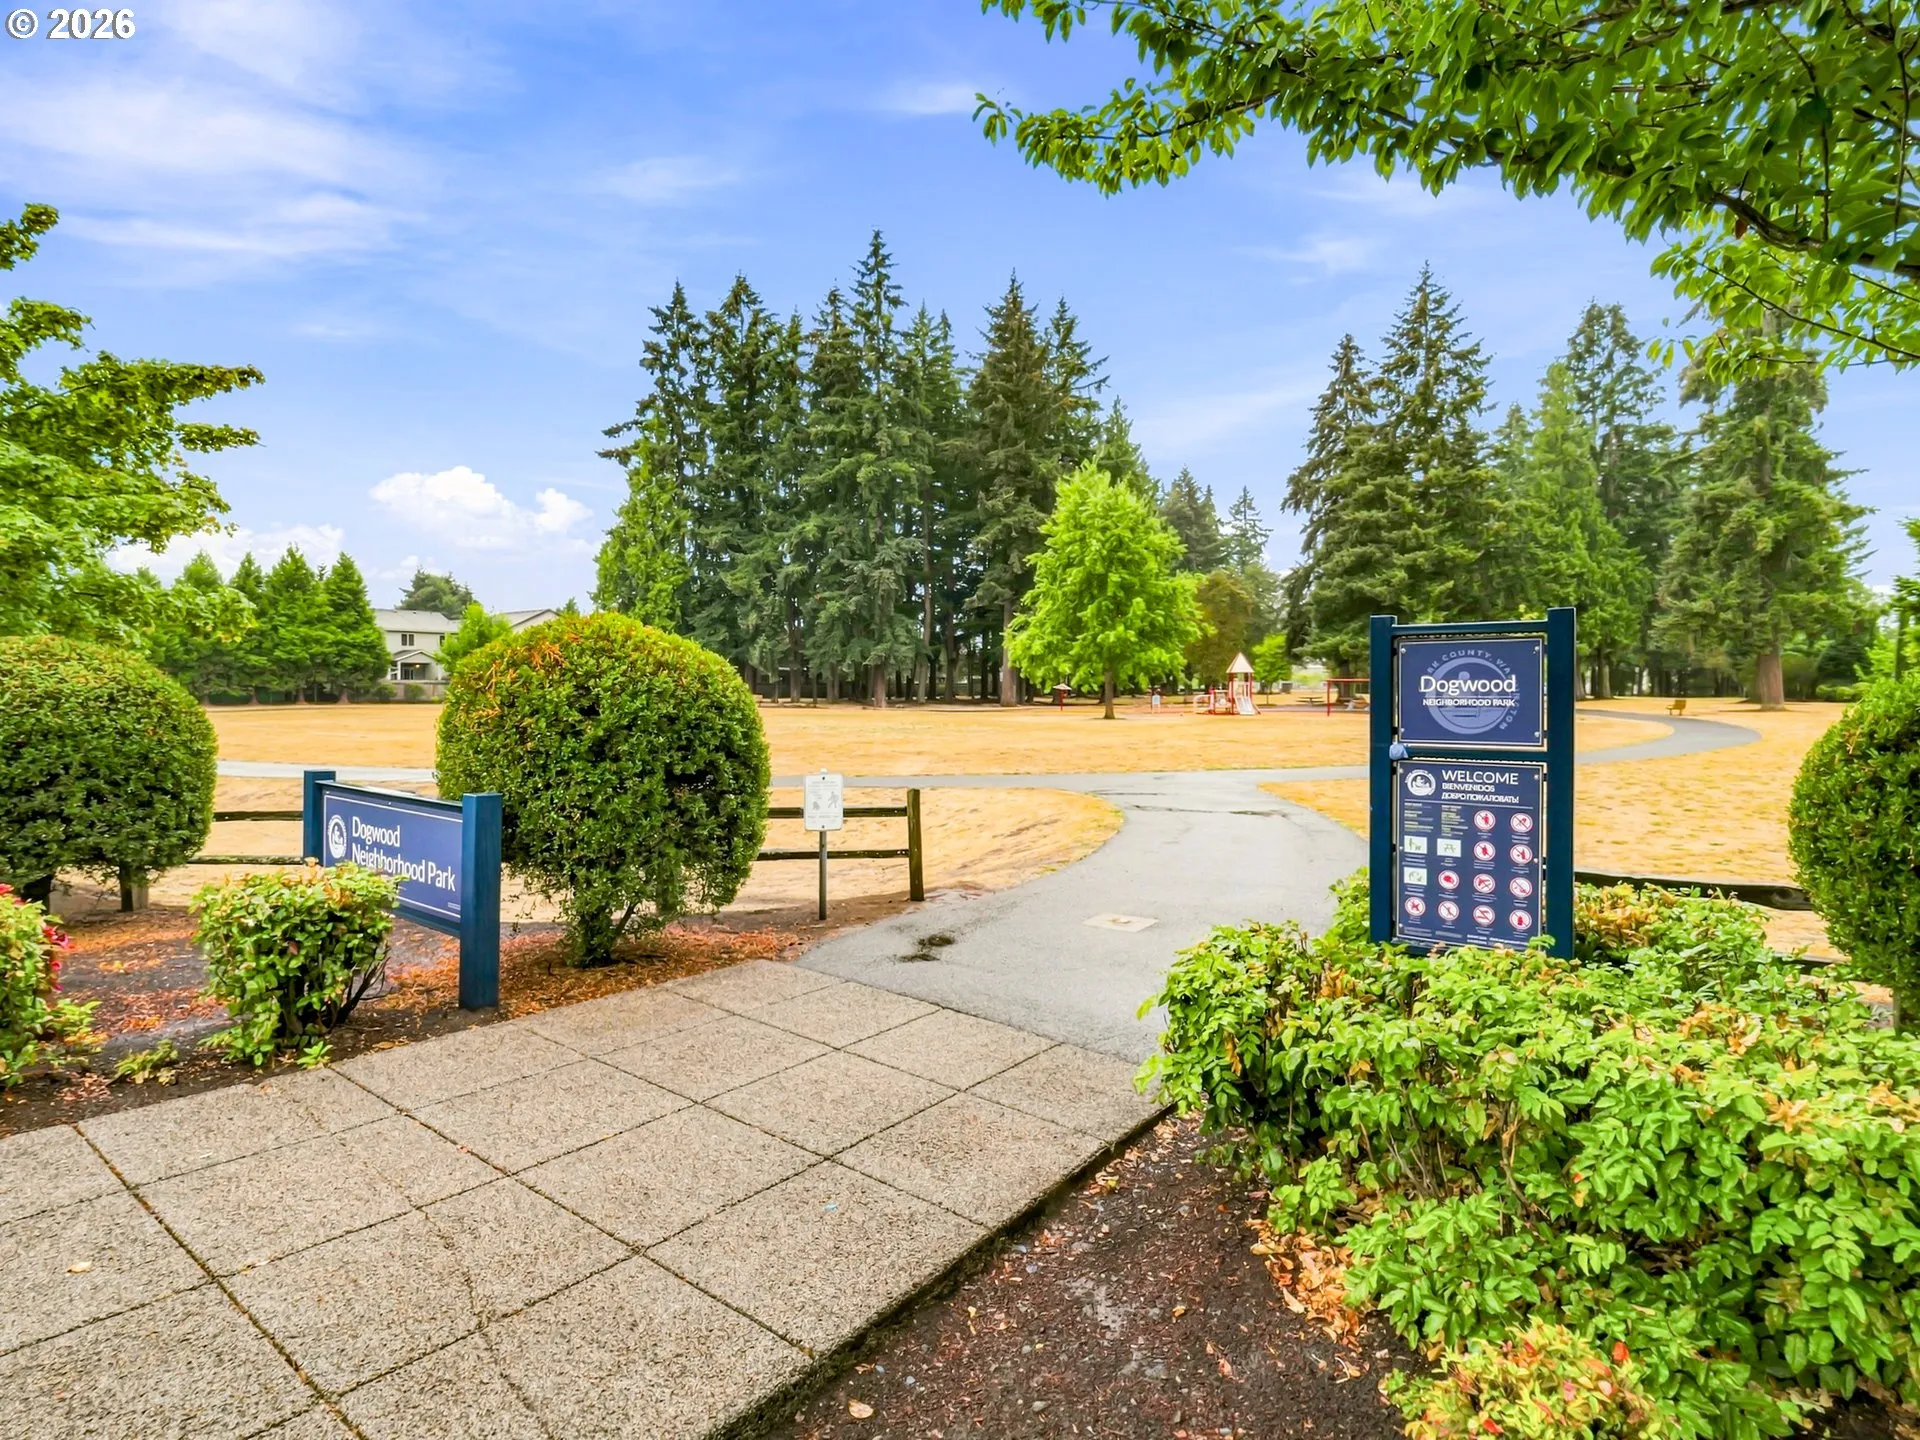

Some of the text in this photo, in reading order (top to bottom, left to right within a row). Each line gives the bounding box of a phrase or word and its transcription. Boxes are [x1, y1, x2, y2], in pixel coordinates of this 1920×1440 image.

[1441, 649, 1492, 661] COUNTY,
[1420, 674, 1516, 695] Dogwood
[1422, 698, 1515, 707] NEIGHBORHOOD PARK
[1442, 769, 1519, 785] WELCOME
[1441, 782, 1495, 792] BIENVENIDOS
[1441, 792, 1466, 800] ДОБРО
[352, 816, 400, 848] Dogwood
[352, 843, 456, 892] Neighborhood Park
